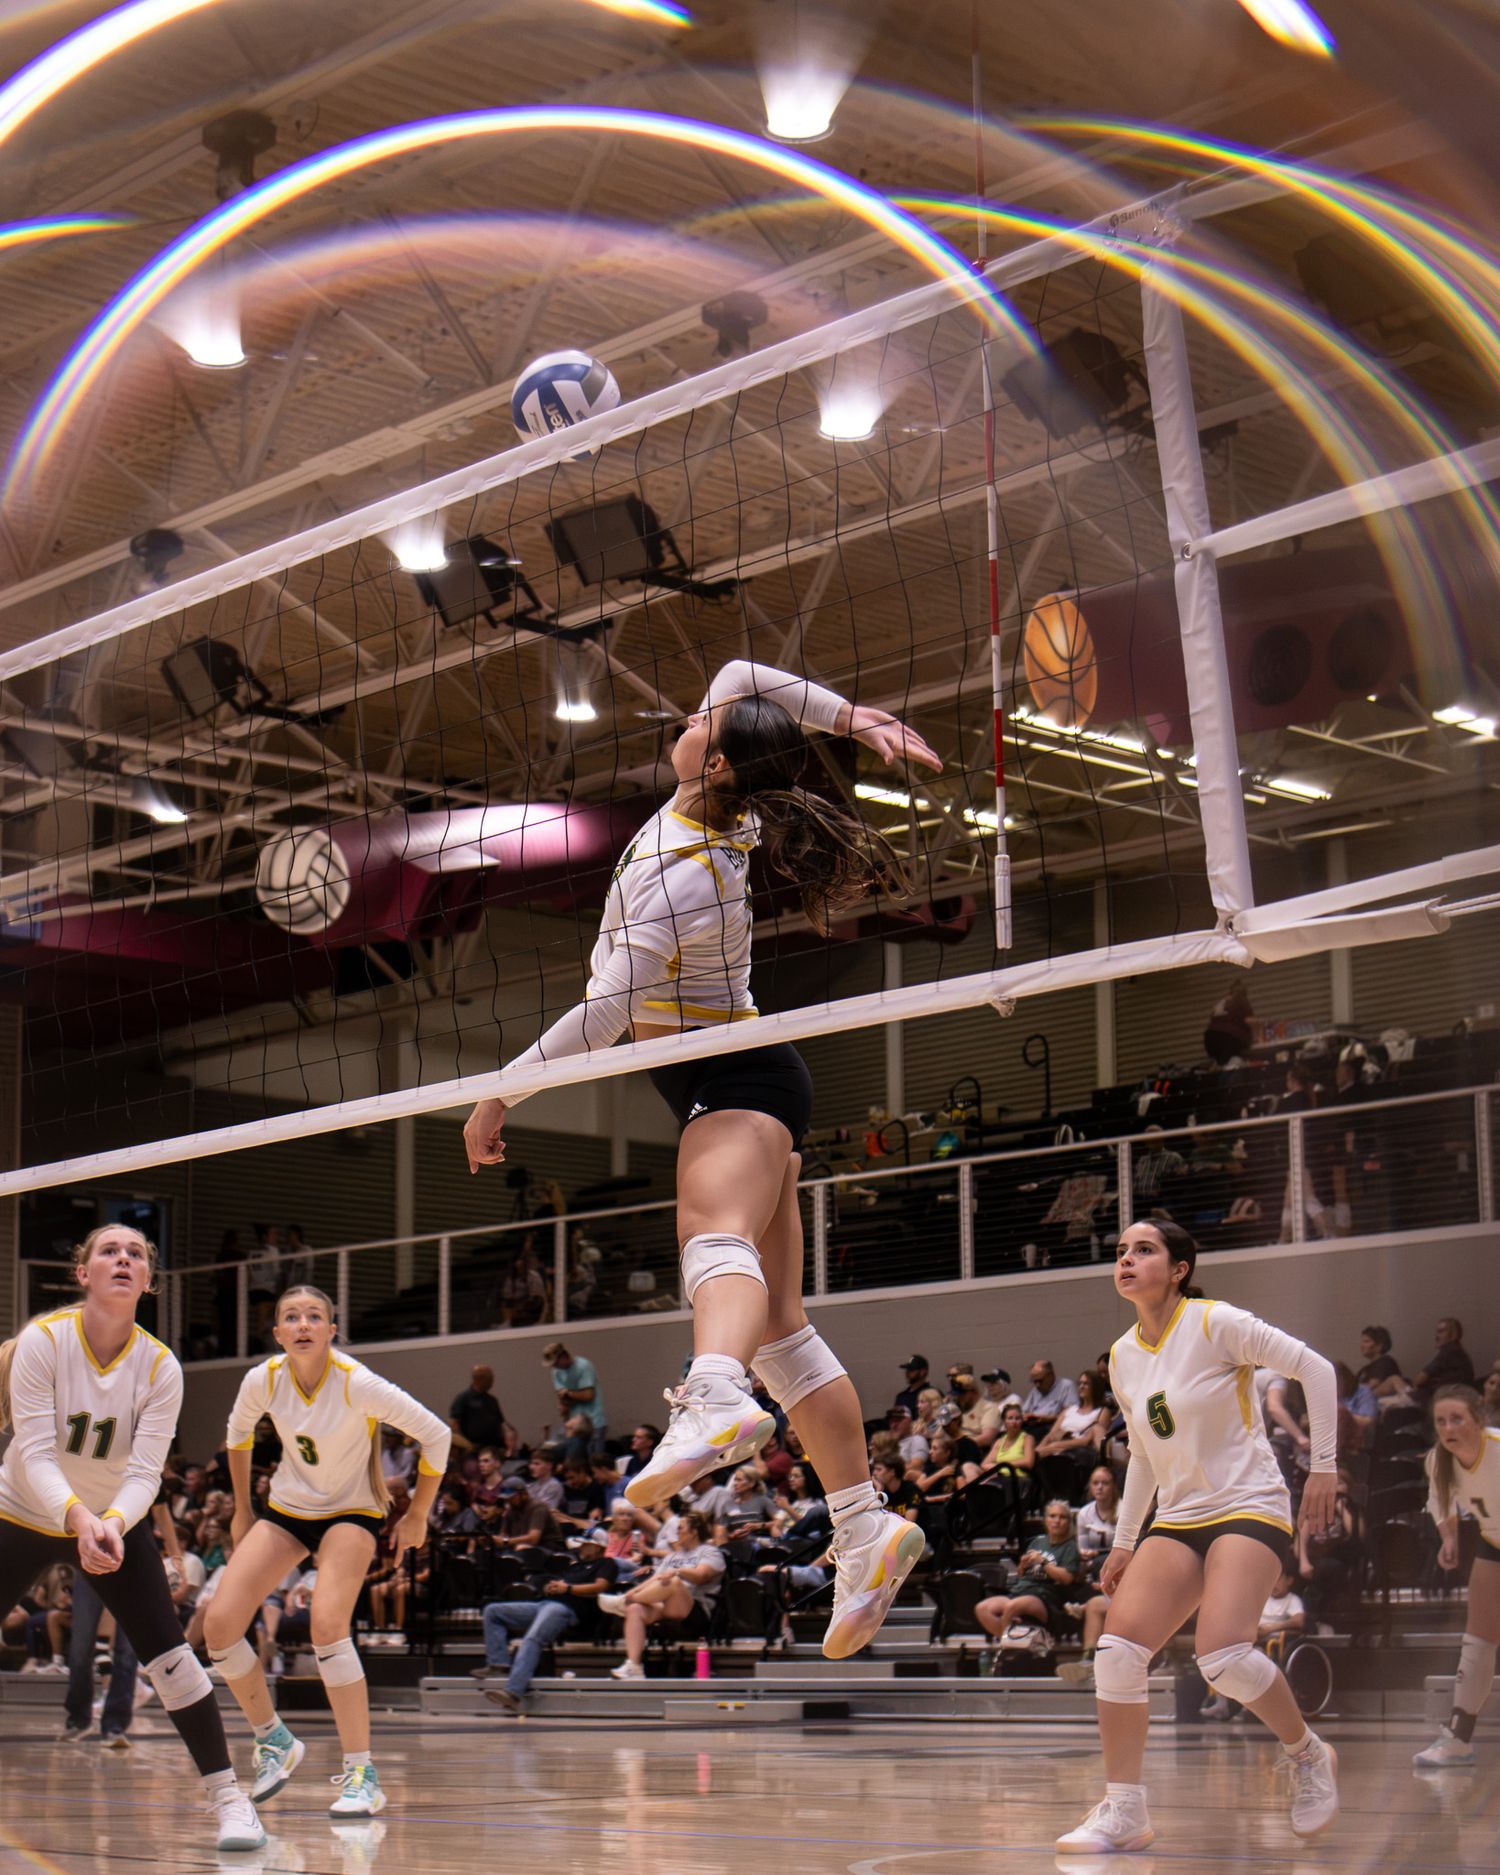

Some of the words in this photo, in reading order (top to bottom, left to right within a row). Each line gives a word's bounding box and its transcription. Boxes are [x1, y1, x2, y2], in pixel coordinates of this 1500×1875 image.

[65, 1411, 117, 1460] 11
[1146, 1390, 1175, 1440] 5
[295, 1435, 319, 1466] 3
